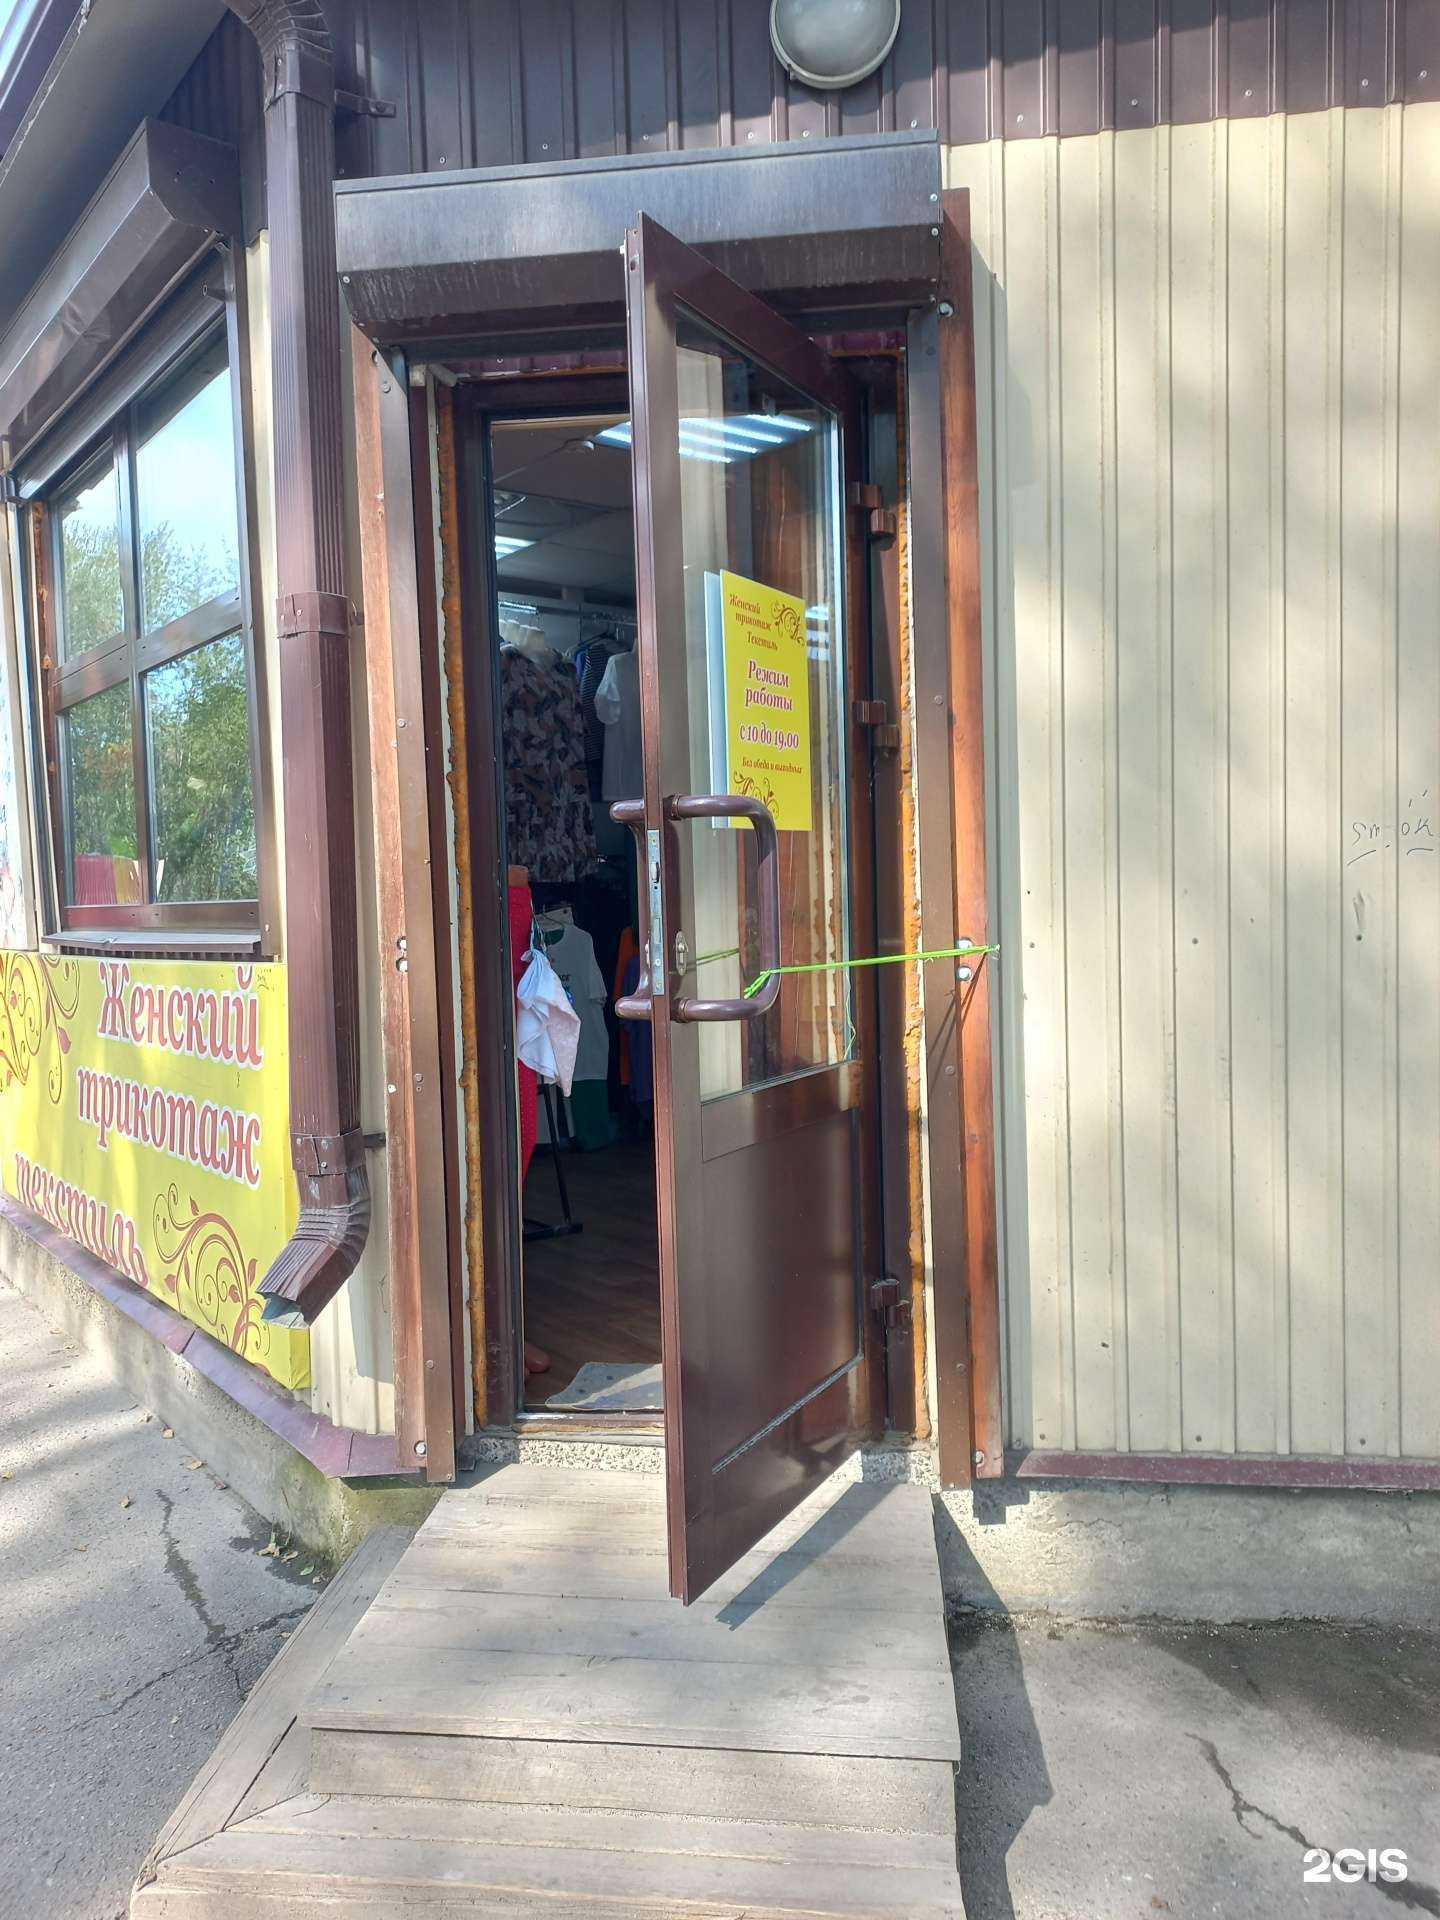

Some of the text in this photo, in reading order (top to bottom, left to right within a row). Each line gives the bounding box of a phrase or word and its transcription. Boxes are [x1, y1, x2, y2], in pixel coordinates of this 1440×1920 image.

[729, 593, 761, 614] Женский
[735, 611, 772, 632] трикотаж
[747, 631, 778, 651] Текстиль
[748, 660, 790, 688] Режим
[745, 687, 793, 711] работы
[740, 723, 799, 750] с 10 до 19.00
[742, 756, 753, 767] Без
[753, 757, 769, 769] обеда
[98, 961, 262, 1067] Женский
[77, 1069, 261, 1187] трикотаж
[15, 1153, 150, 1288] текстиль
